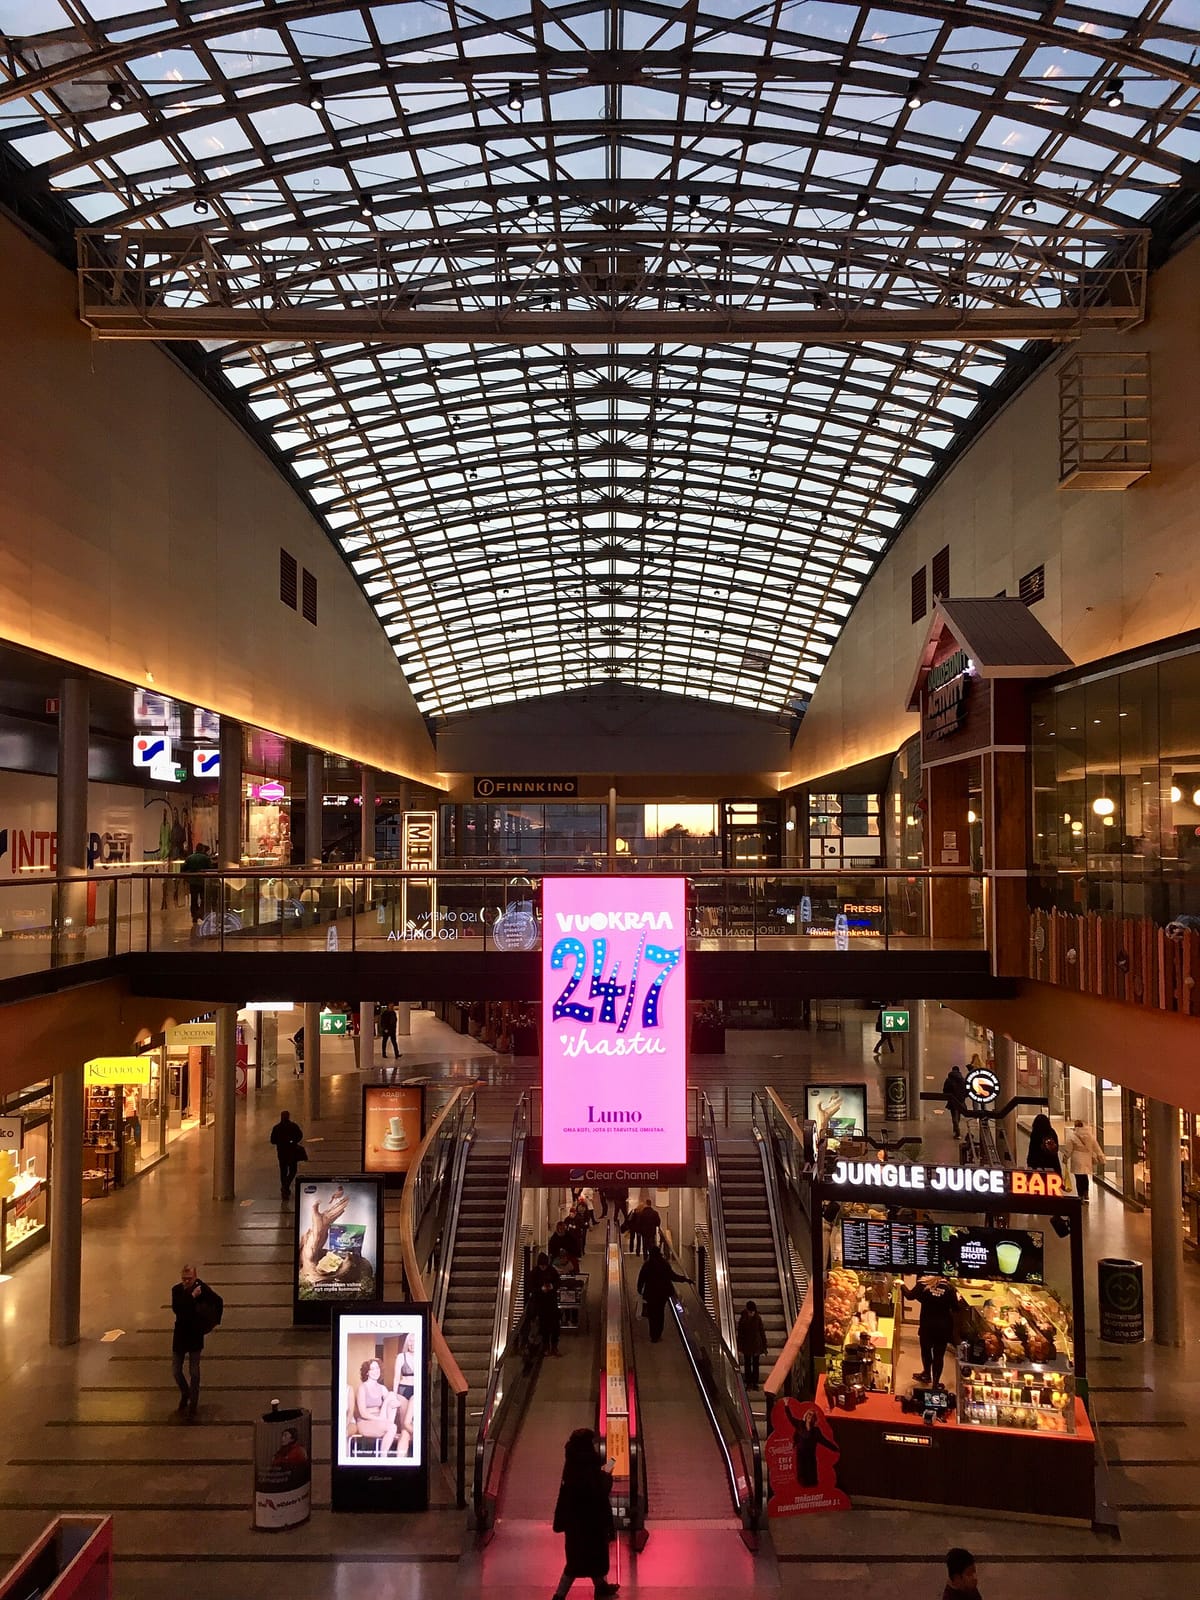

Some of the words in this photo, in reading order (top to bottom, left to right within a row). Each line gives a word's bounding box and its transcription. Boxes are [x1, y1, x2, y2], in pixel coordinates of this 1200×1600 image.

[927, 676, 964, 719] ACTIVITY
[496, 783, 575, 792] FINNKINO
[843, 903, 882, 913] FRESSI
[555, 911, 673, 932] VUOKRAA
[550, 930, 682, 1033] 24/7
[559, 1028, 666, 1057] ihastu
[587, 1106, 642, 1123] Lumo
[585, 1169, 614, 1180] Clear
[615, 1169, 659, 1180] Channel
[831, 1161, 926, 1189] JUNGLE
[930, 1166, 1005, 1193] JUICE
[1011, 1171, 1063, 1196] BAR
[960, 1252, 987, 1261] SHOTTI
